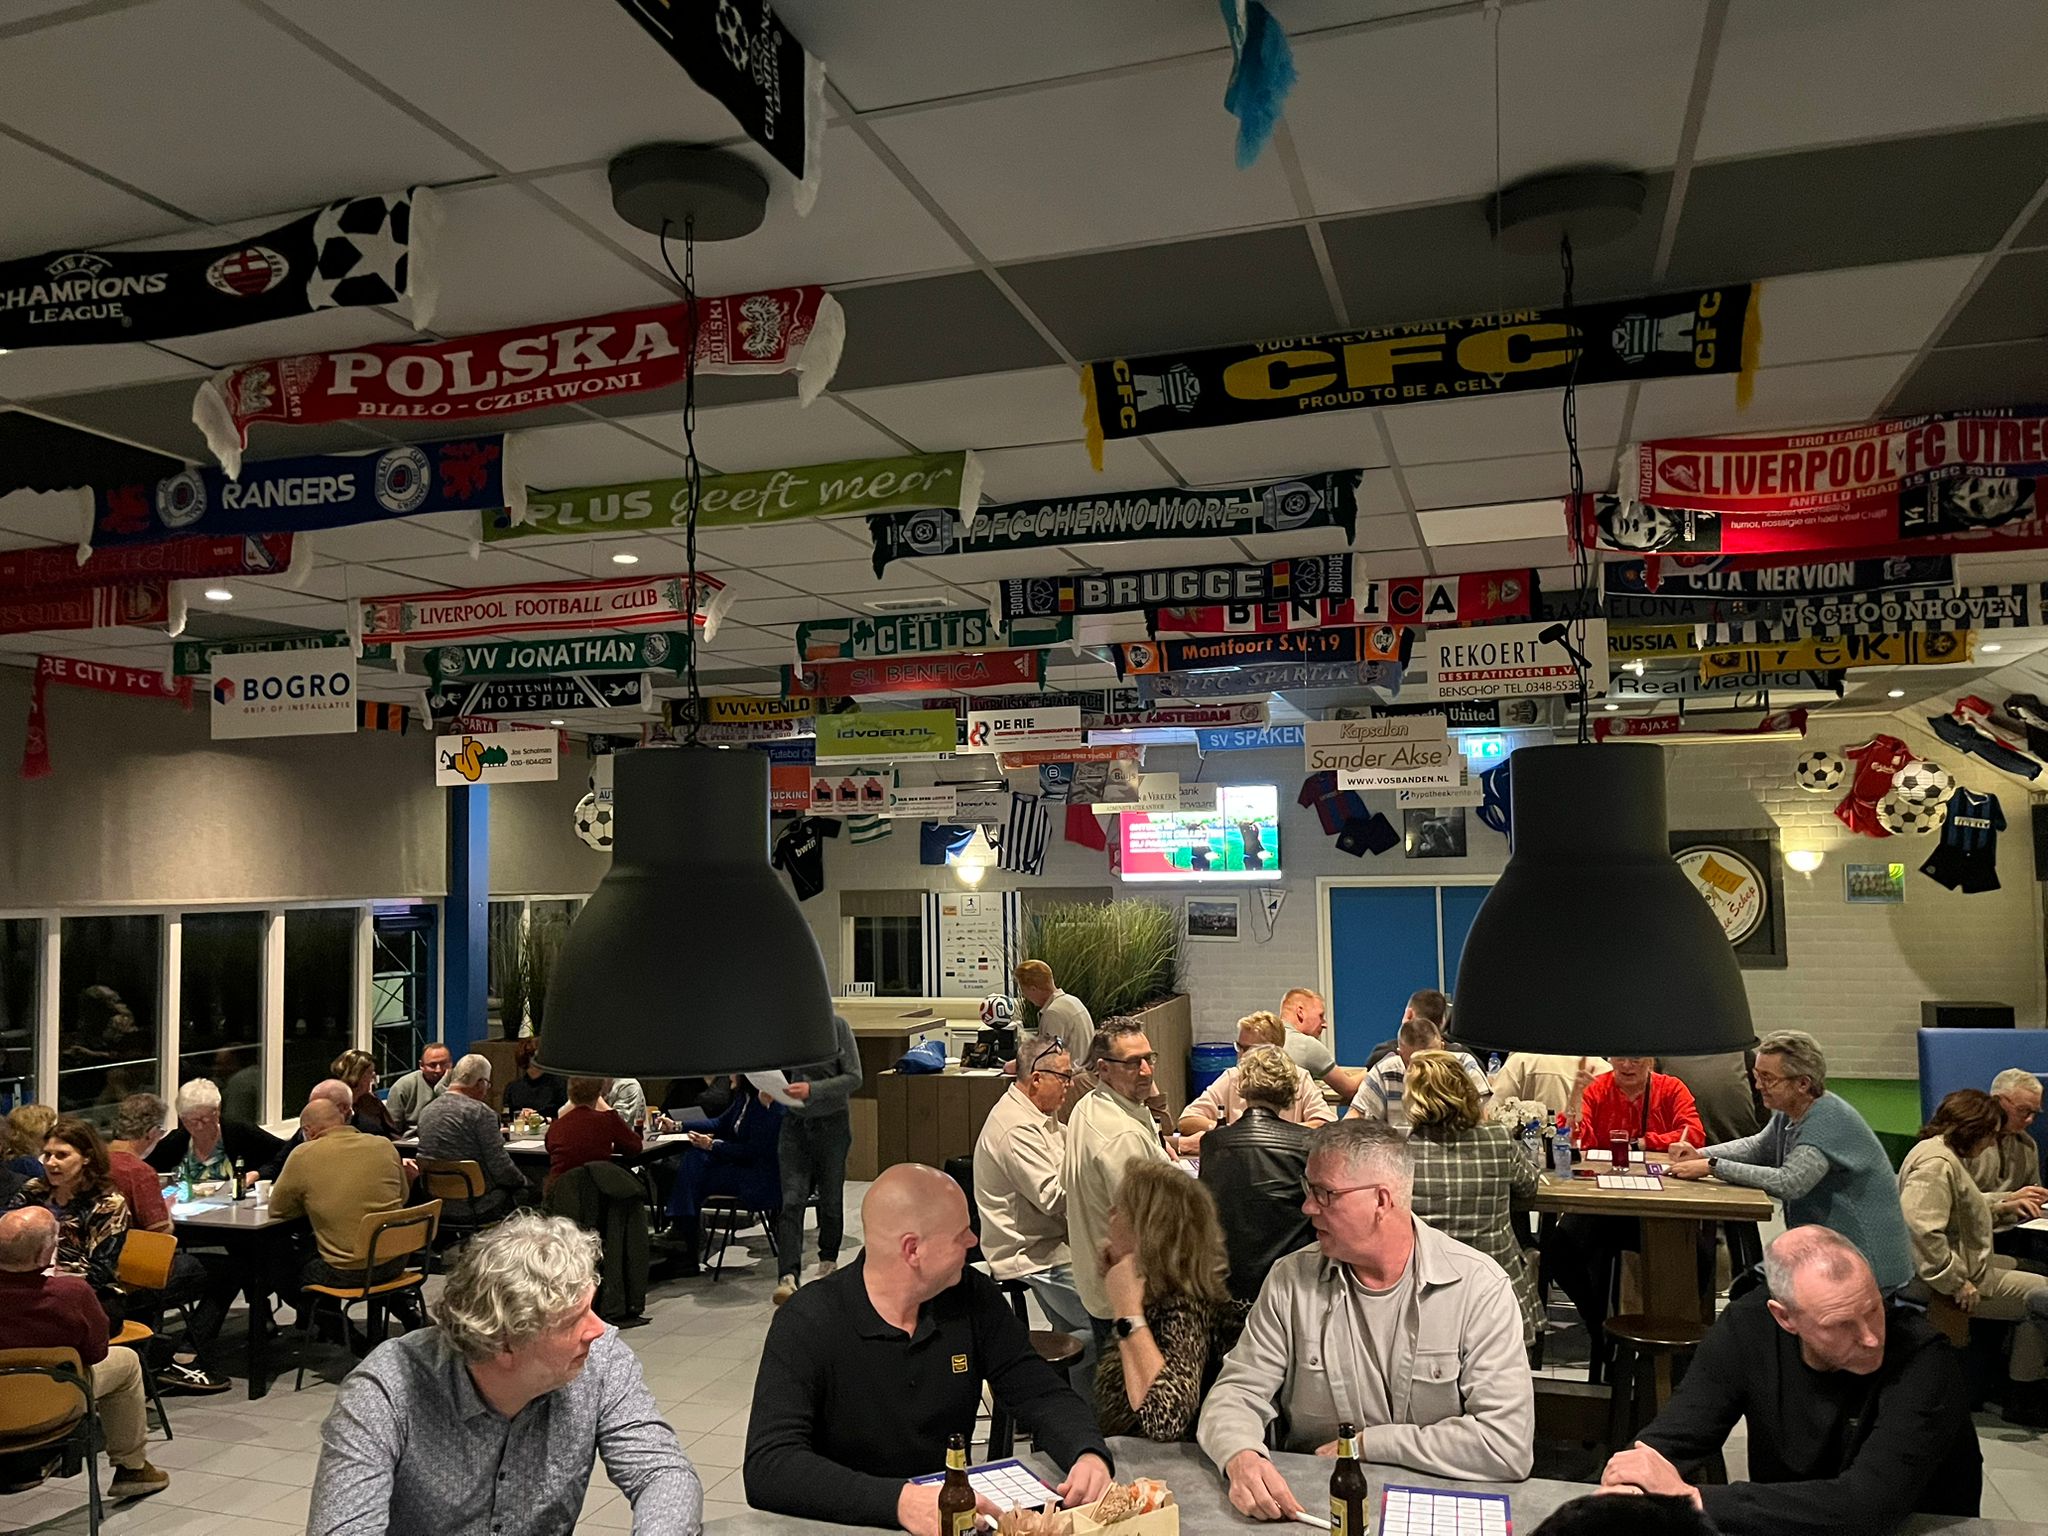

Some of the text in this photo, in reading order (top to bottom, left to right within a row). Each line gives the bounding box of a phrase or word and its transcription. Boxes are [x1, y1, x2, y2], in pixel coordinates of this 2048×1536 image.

[760, 1, 774, 141] CHAMPIONS
[29, 303, 123, 324] LEAGUE
[1470, 309, 1542, 328] ALONE
[1694, 290, 1722, 370] CFC
[326, 320, 680, 399] POLSKA
[1222, 321, 1584, 402] CFC
[1112, 358, 1137, 430] CFC
[1298, 389, 1366, 410] PROUD
[1374, 385, 1398, 402] TO
[1403, 381, 1429, 399] BE
[1433, 380, 1449, 395] A
[1788, 436, 1825, 450] EURO
[1829, 425, 1881, 446] LEAGUE
[1885, 413, 1932, 434] GROUP
[1702, 440, 1896, 498] LIVERPOOL
[1906, 422, 1946, 475] FC
[222, 472, 356, 511] RANGERS
[526, 489, 652, 526] PLUS
[670, 469, 809, 529] geeft
[1789, 490, 1852, 508] ANFIELD
[1856, 481, 1899, 500] ROAD
[1930, 465, 1963, 481] DEC
[1966, 466, 2006, 478] 2010
[970, 508, 1027, 545] PFC
[1080, 567, 1266, 610] BRUGGE
[1756, 561, 1856, 592] NERVION
[420, 588, 659, 625] LIVERPOOL FOOTBALL CLUB
[1802, 595, 2023, 627] SCHOONHOVEN
[466, 638, 636, 670] VV JONATHAN
[1182, 637, 1274, 660] Montfoort
[1441, 641, 1539, 668] REKOERT
[75, 657, 118, 686] CITY
[127, 667, 151, 689] FC
[886, 661, 991, 686] BENFICA
[1439, 665, 1576, 682] BESTRATINGEN B.V.
[1618, 669, 1801, 696] Real Madrid
[243, 672, 350, 702] BOGRO
[489, 681, 575, 695] TOTTENHAM
[1439, 679, 1595, 698] BENSCHOP TEL.0348-55382
[481, 692, 585, 710] HOTSPUR
[716, 697, 810, 717] VVV-VENLO
[1450, 706, 1496, 723] United
[994, 718, 1035, 731] DE RIE
[1103, 709, 1232, 727] AJAX AMSTERDAM
[1339, 719, 1409, 742] Kapsalon
[1640, 720, 1669, 732] AJAX
[1211, 734, 1230, 747] SV
[1311, 743, 1443, 771] Sander Akse
[1347, 774, 1450, 787] WWW.VOSBANDEN.NL
[599, 790, 613, 800] AU
[795, 837, 817, 858] bwin
